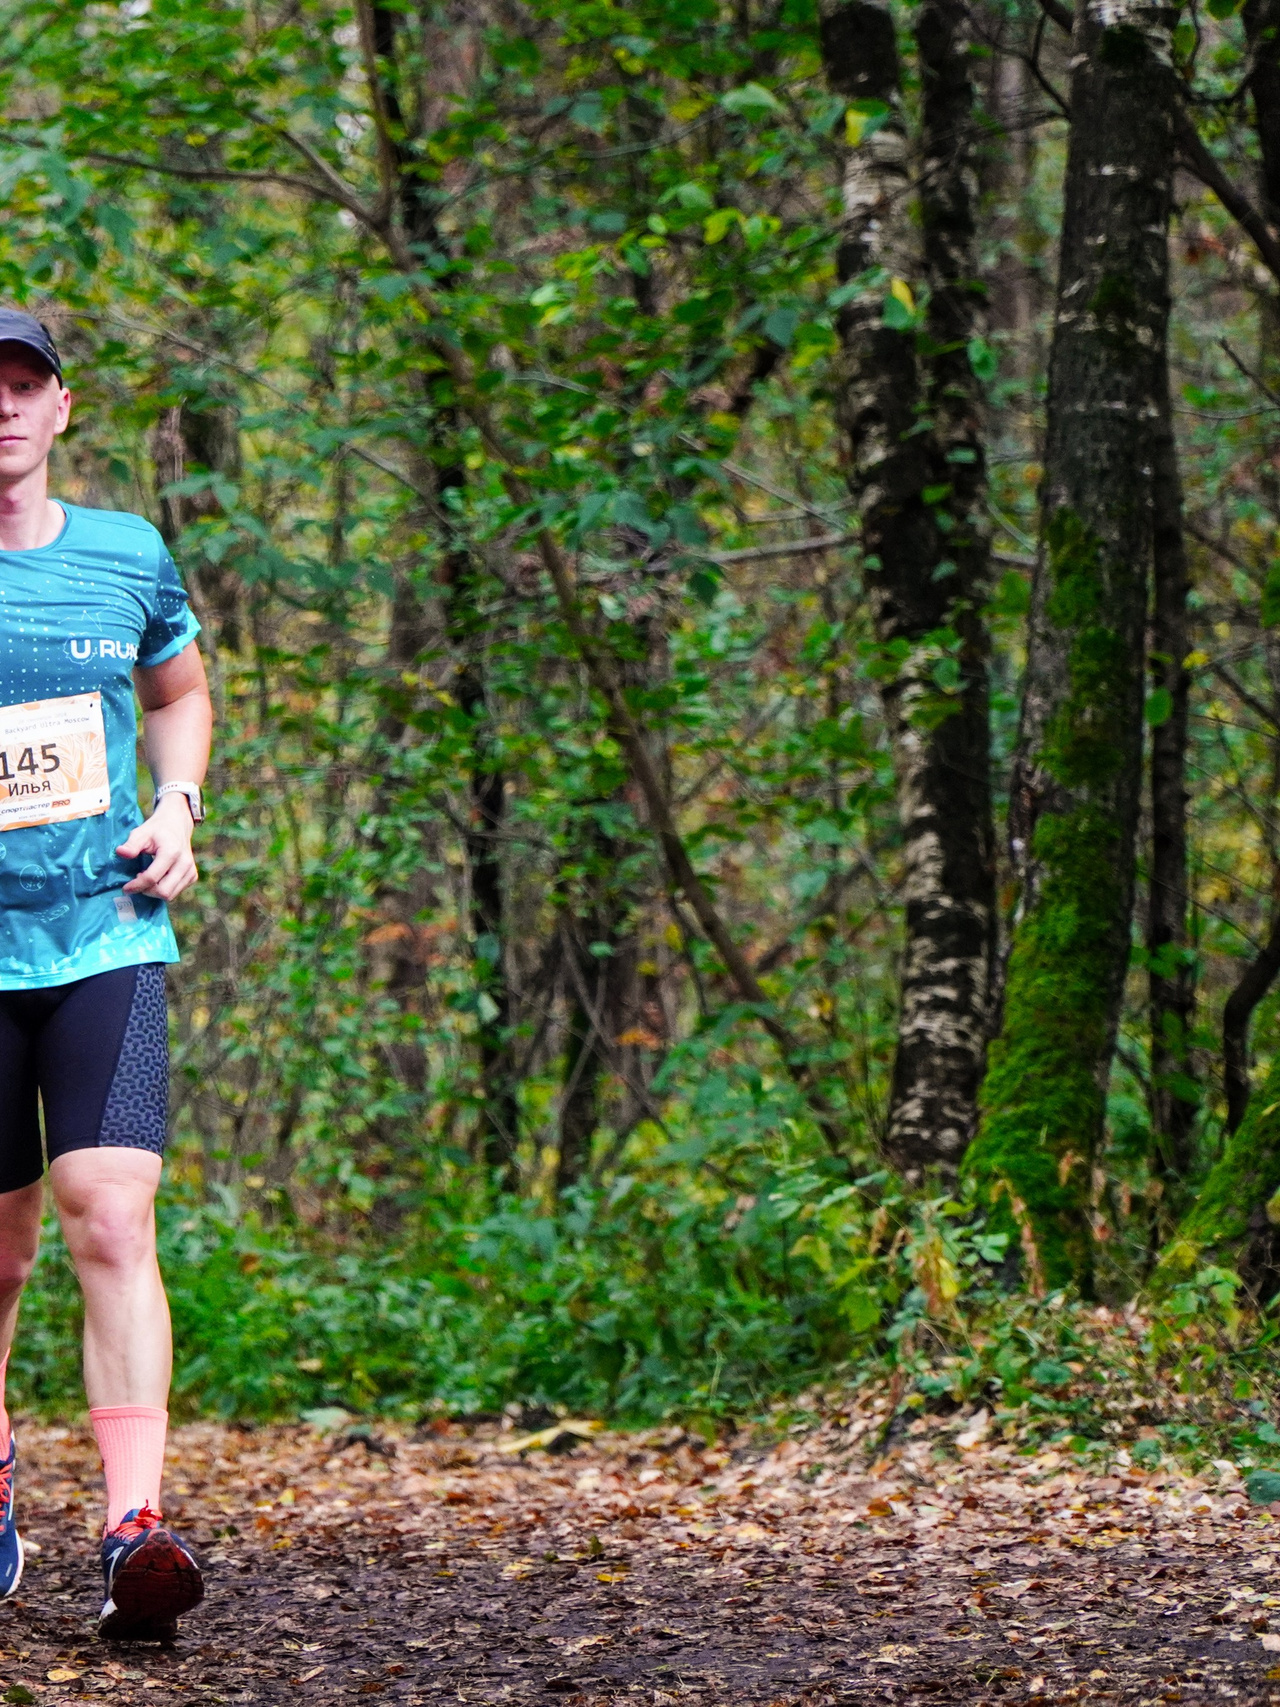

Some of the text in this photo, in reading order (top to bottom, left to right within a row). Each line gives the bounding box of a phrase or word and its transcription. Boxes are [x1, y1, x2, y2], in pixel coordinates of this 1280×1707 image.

[70, 639, 91, 659] U
[5, 723, 37, 735] Backyard
[40, 720, 61, 729] Ultra
[64, 716, 90, 725] Moscow
[8, 781, 51, 797] Илья
[51, 799, 71, 808] PRO
